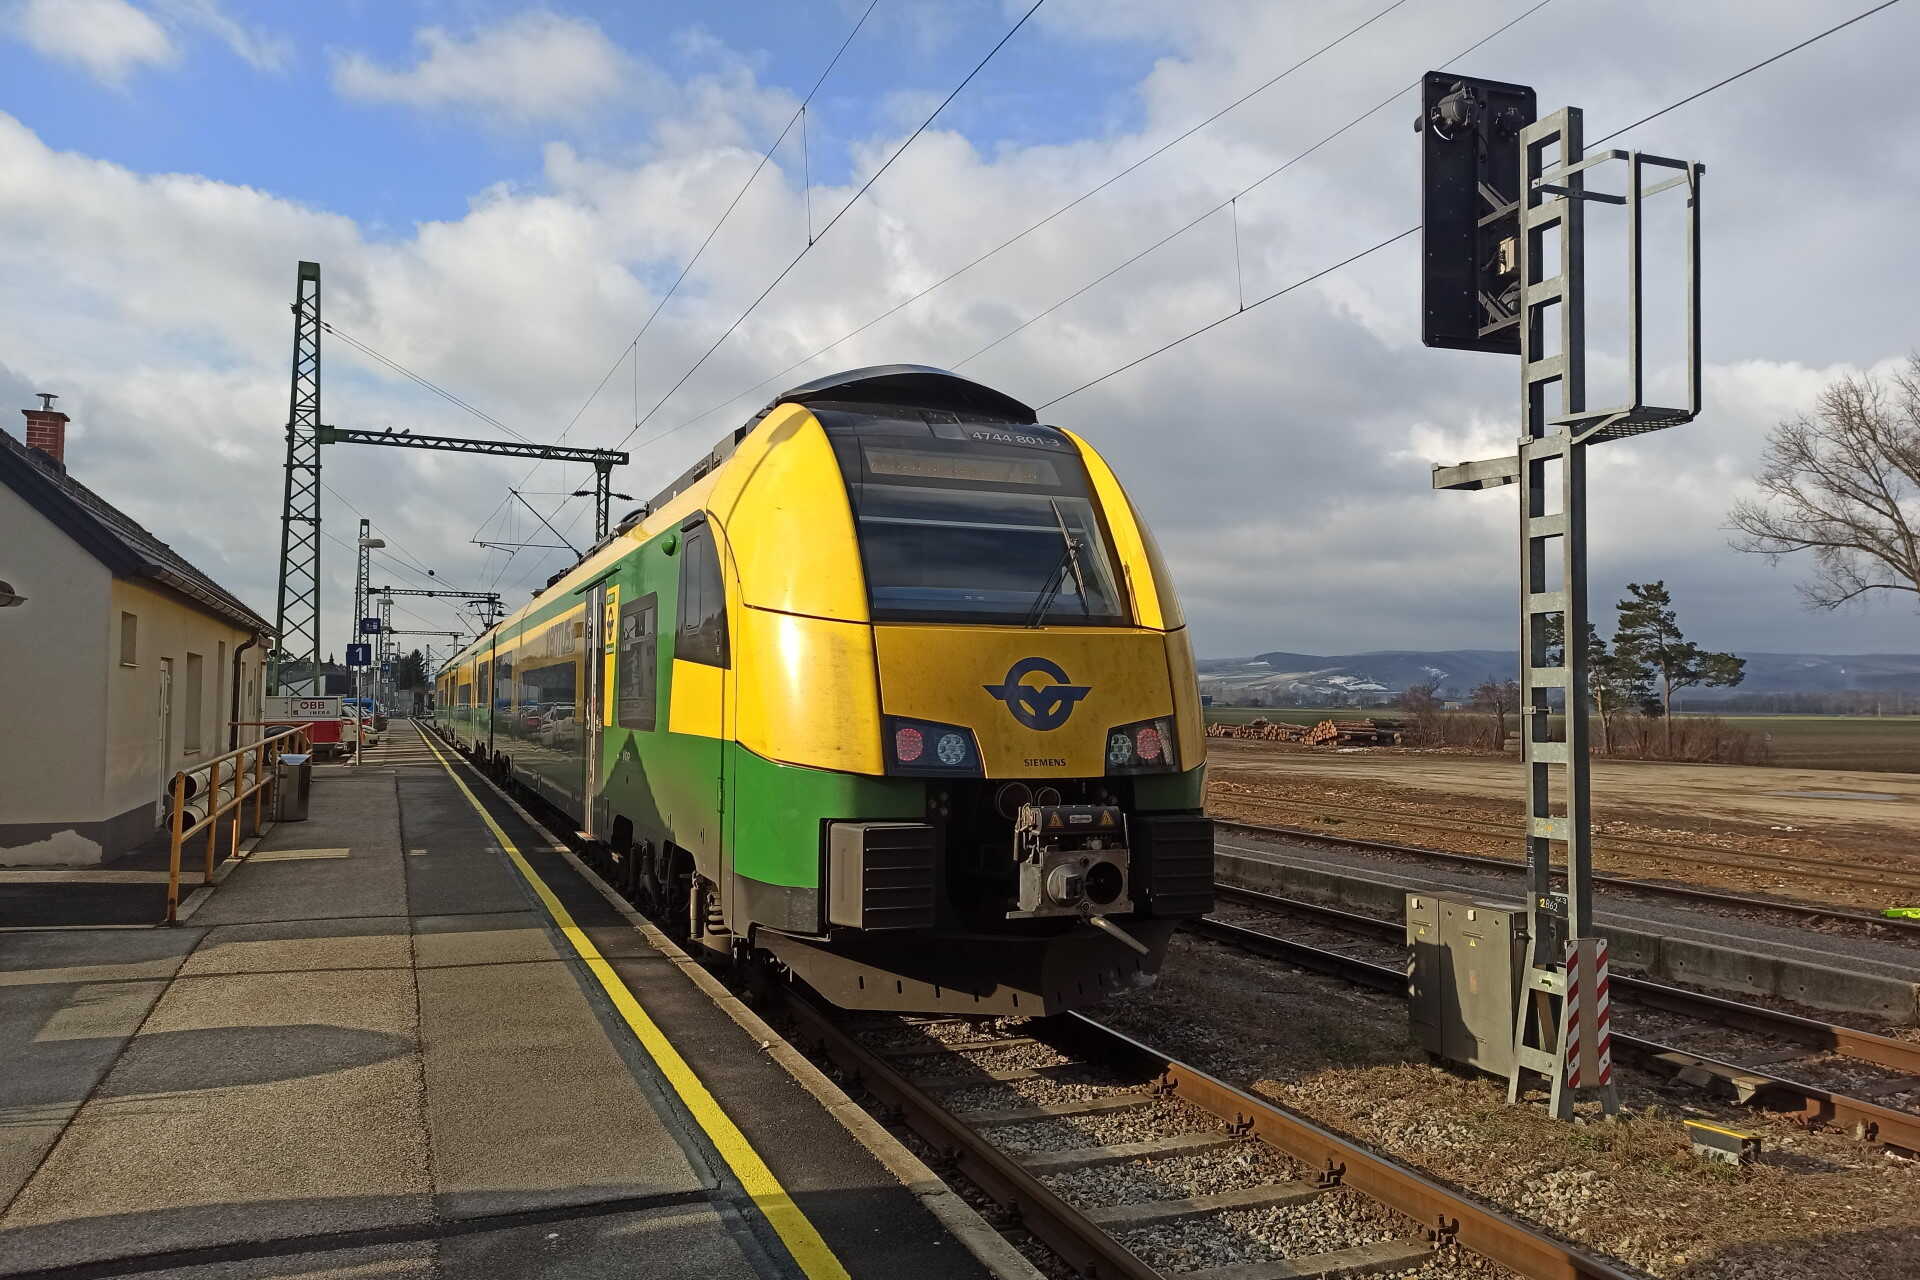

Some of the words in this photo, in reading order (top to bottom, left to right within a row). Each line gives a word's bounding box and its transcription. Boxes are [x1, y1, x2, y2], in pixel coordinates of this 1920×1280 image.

[972, 431, 1012, 443] 4744
[1015, 435, 1061, 447] 801-3
[355, 647, 363, 662] 1
[1023, 758, 1067, 767] SIEMENS
